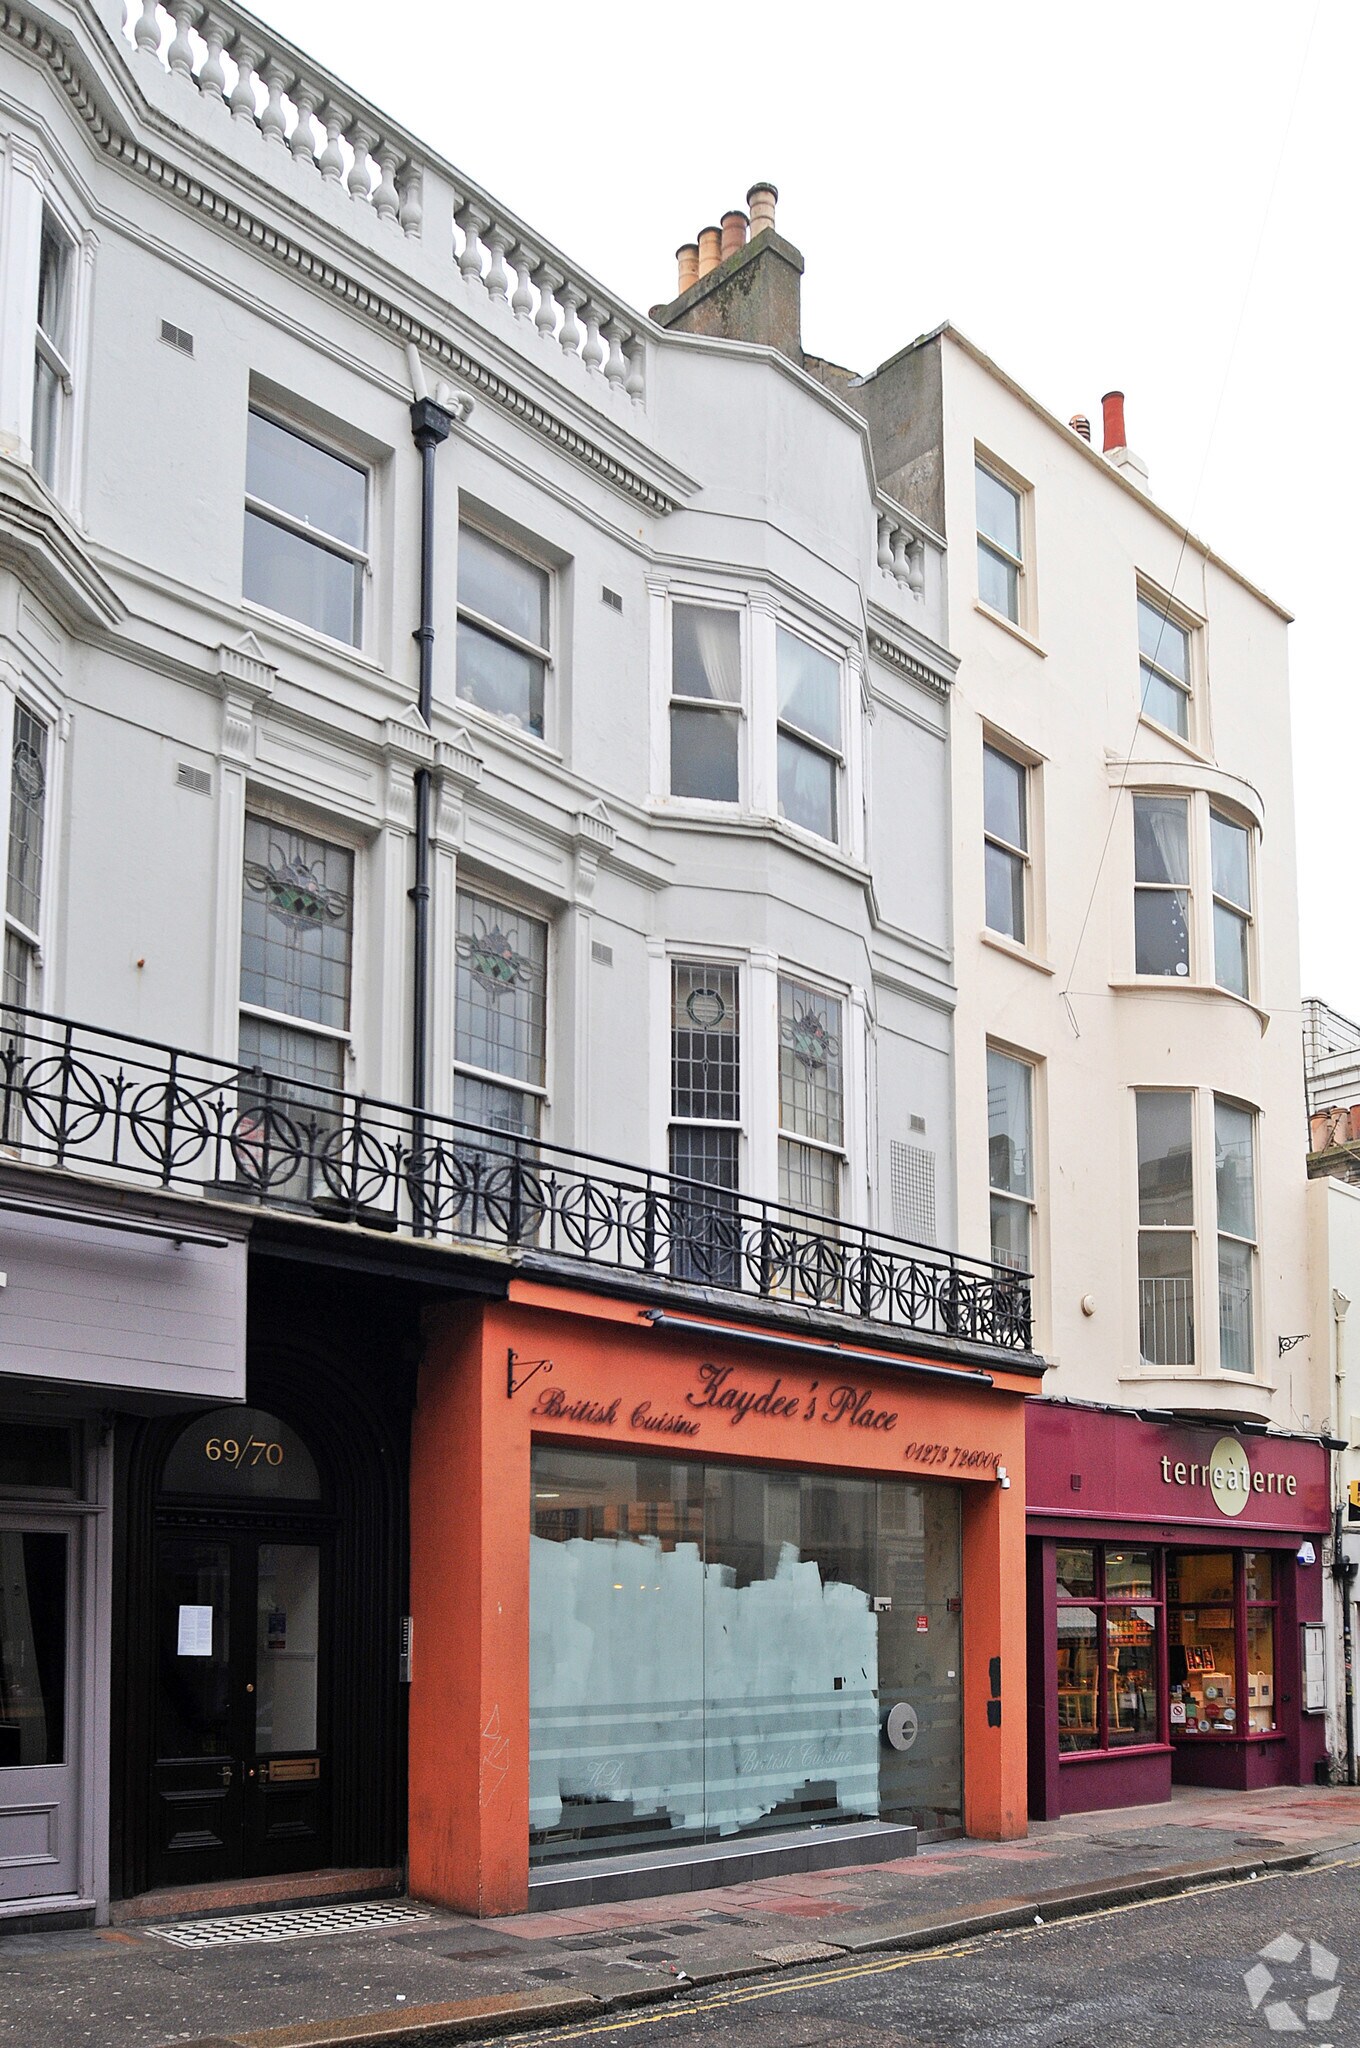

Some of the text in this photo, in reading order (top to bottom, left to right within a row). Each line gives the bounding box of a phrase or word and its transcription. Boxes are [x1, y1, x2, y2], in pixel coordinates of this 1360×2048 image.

[532, 1387, 701, 1435] British Cuisine
[687, 1363, 899, 1431] Kaydee's Place
[205, 1434, 284, 1469] 69/70
[904, 1442, 950, 1465] 01273
[740, 1743, 852, 1773] British Cuisine
